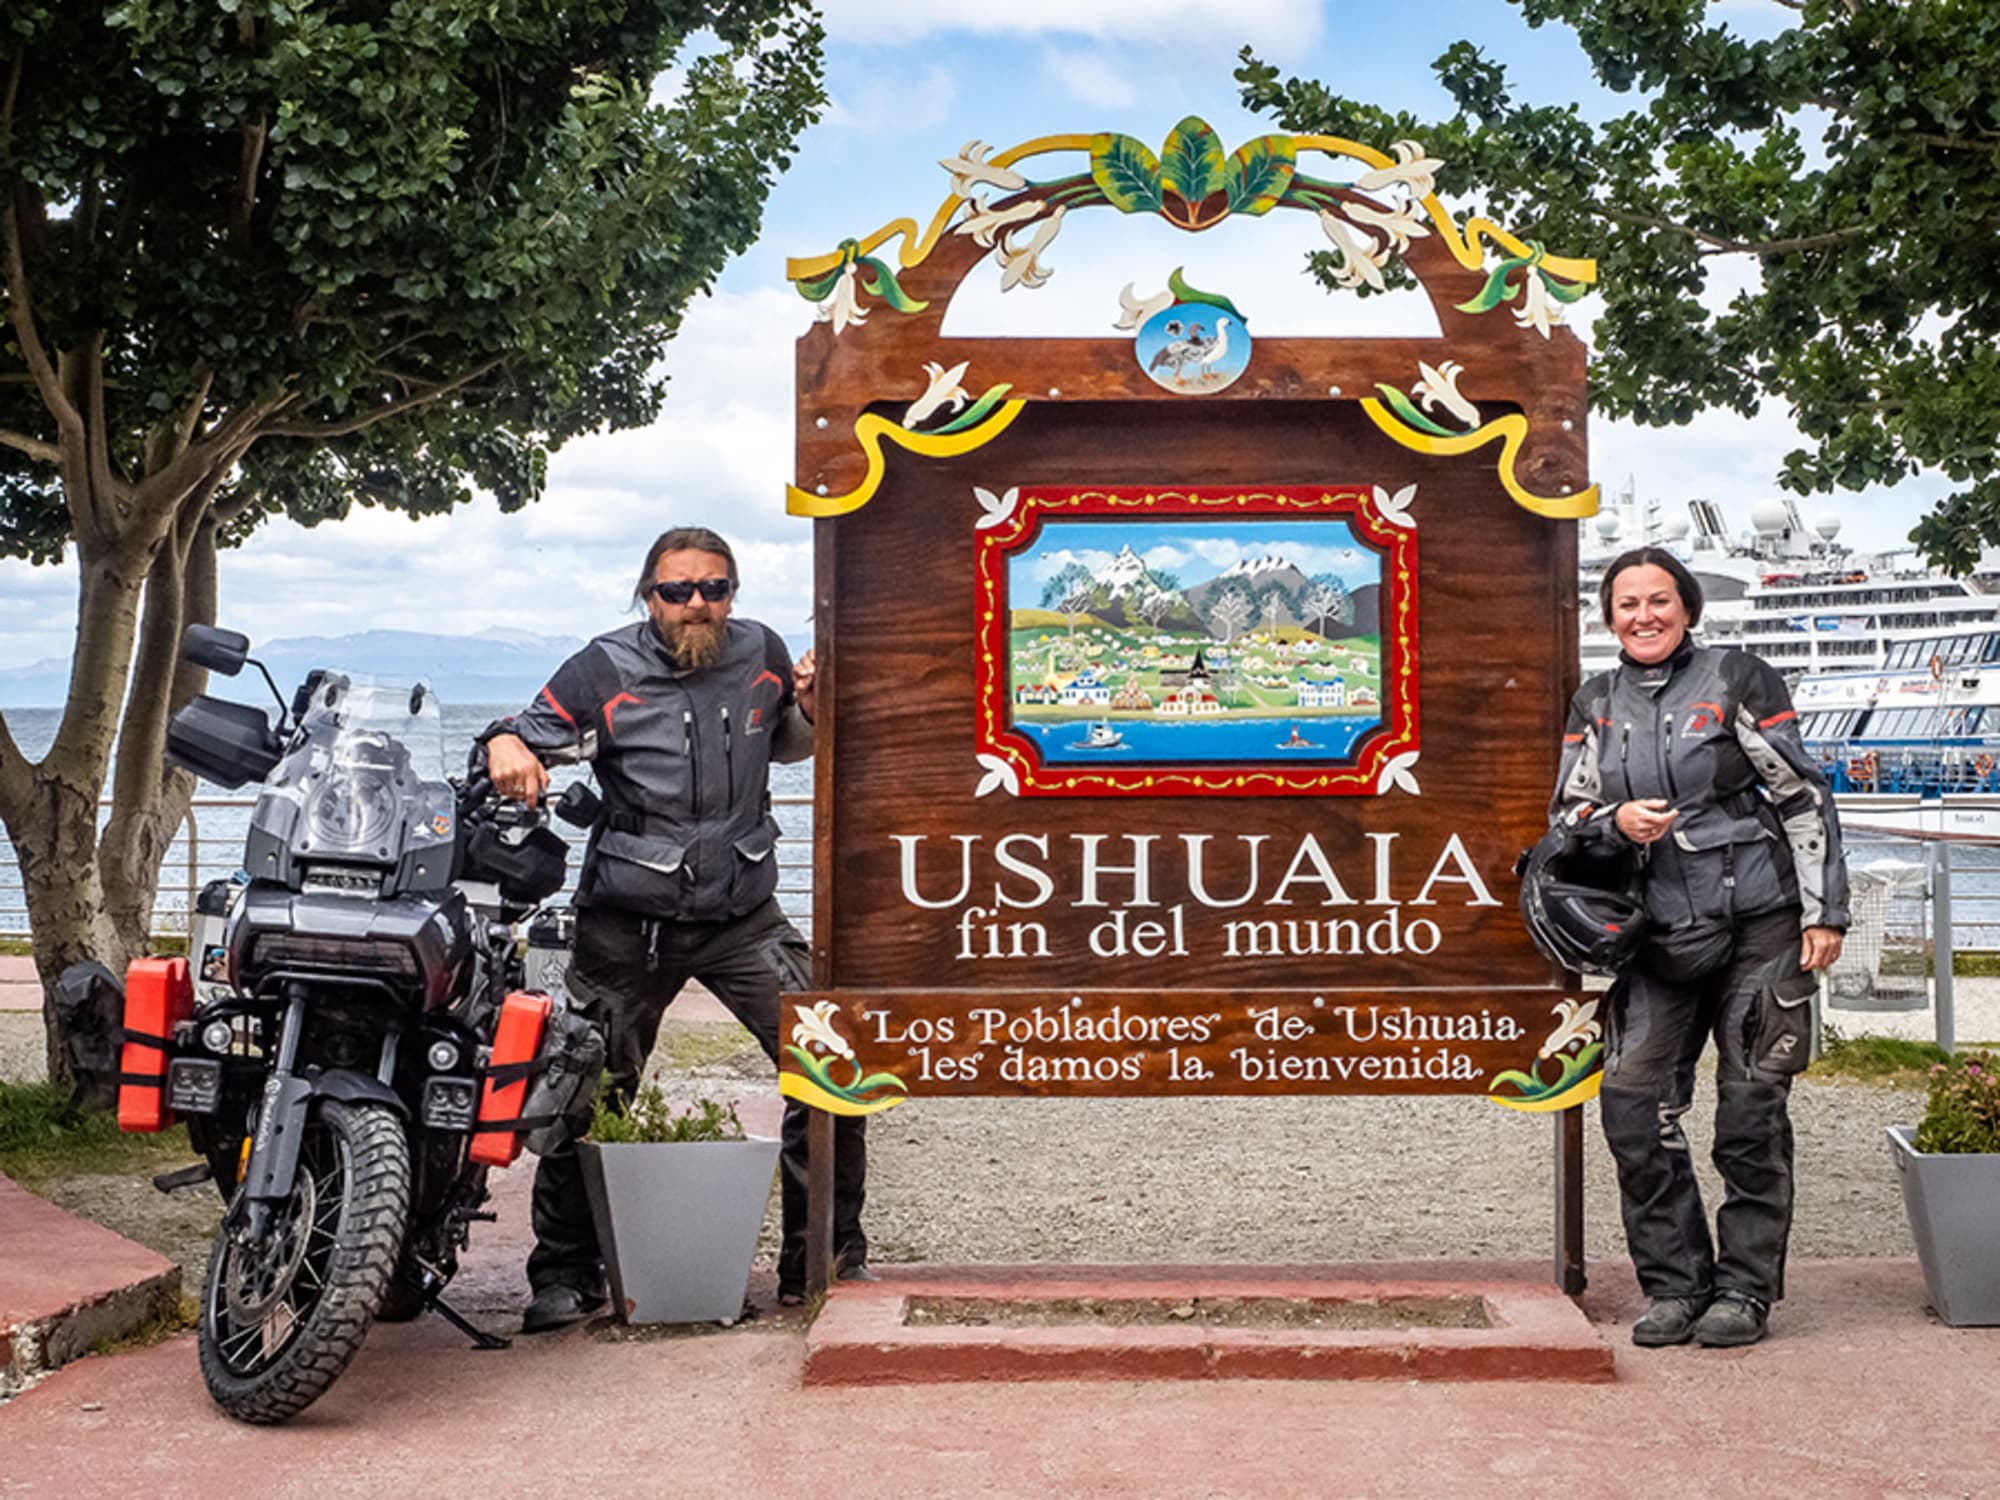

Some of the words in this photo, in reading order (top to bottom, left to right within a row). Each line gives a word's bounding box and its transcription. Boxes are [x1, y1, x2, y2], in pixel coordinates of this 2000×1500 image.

[890, 833, 1502, 908] USHUAIA
[956, 907, 1052, 959] fin
[1089, 904, 1189, 957] del
[1223, 908, 1442, 956] mundo
[863, 1010, 954, 1043] Los
[969, 1006, 1221, 1044] Pobladores
[1248, 1007, 1315, 1041] de
[1334, 1007, 1525, 1041] Ushuaia
[908, 1046, 984, 1081] les
[1000, 1045, 1145, 1081] damos
[1168, 1047, 1214, 1081] la
[1230, 1047, 1484, 1081] bienvenida
